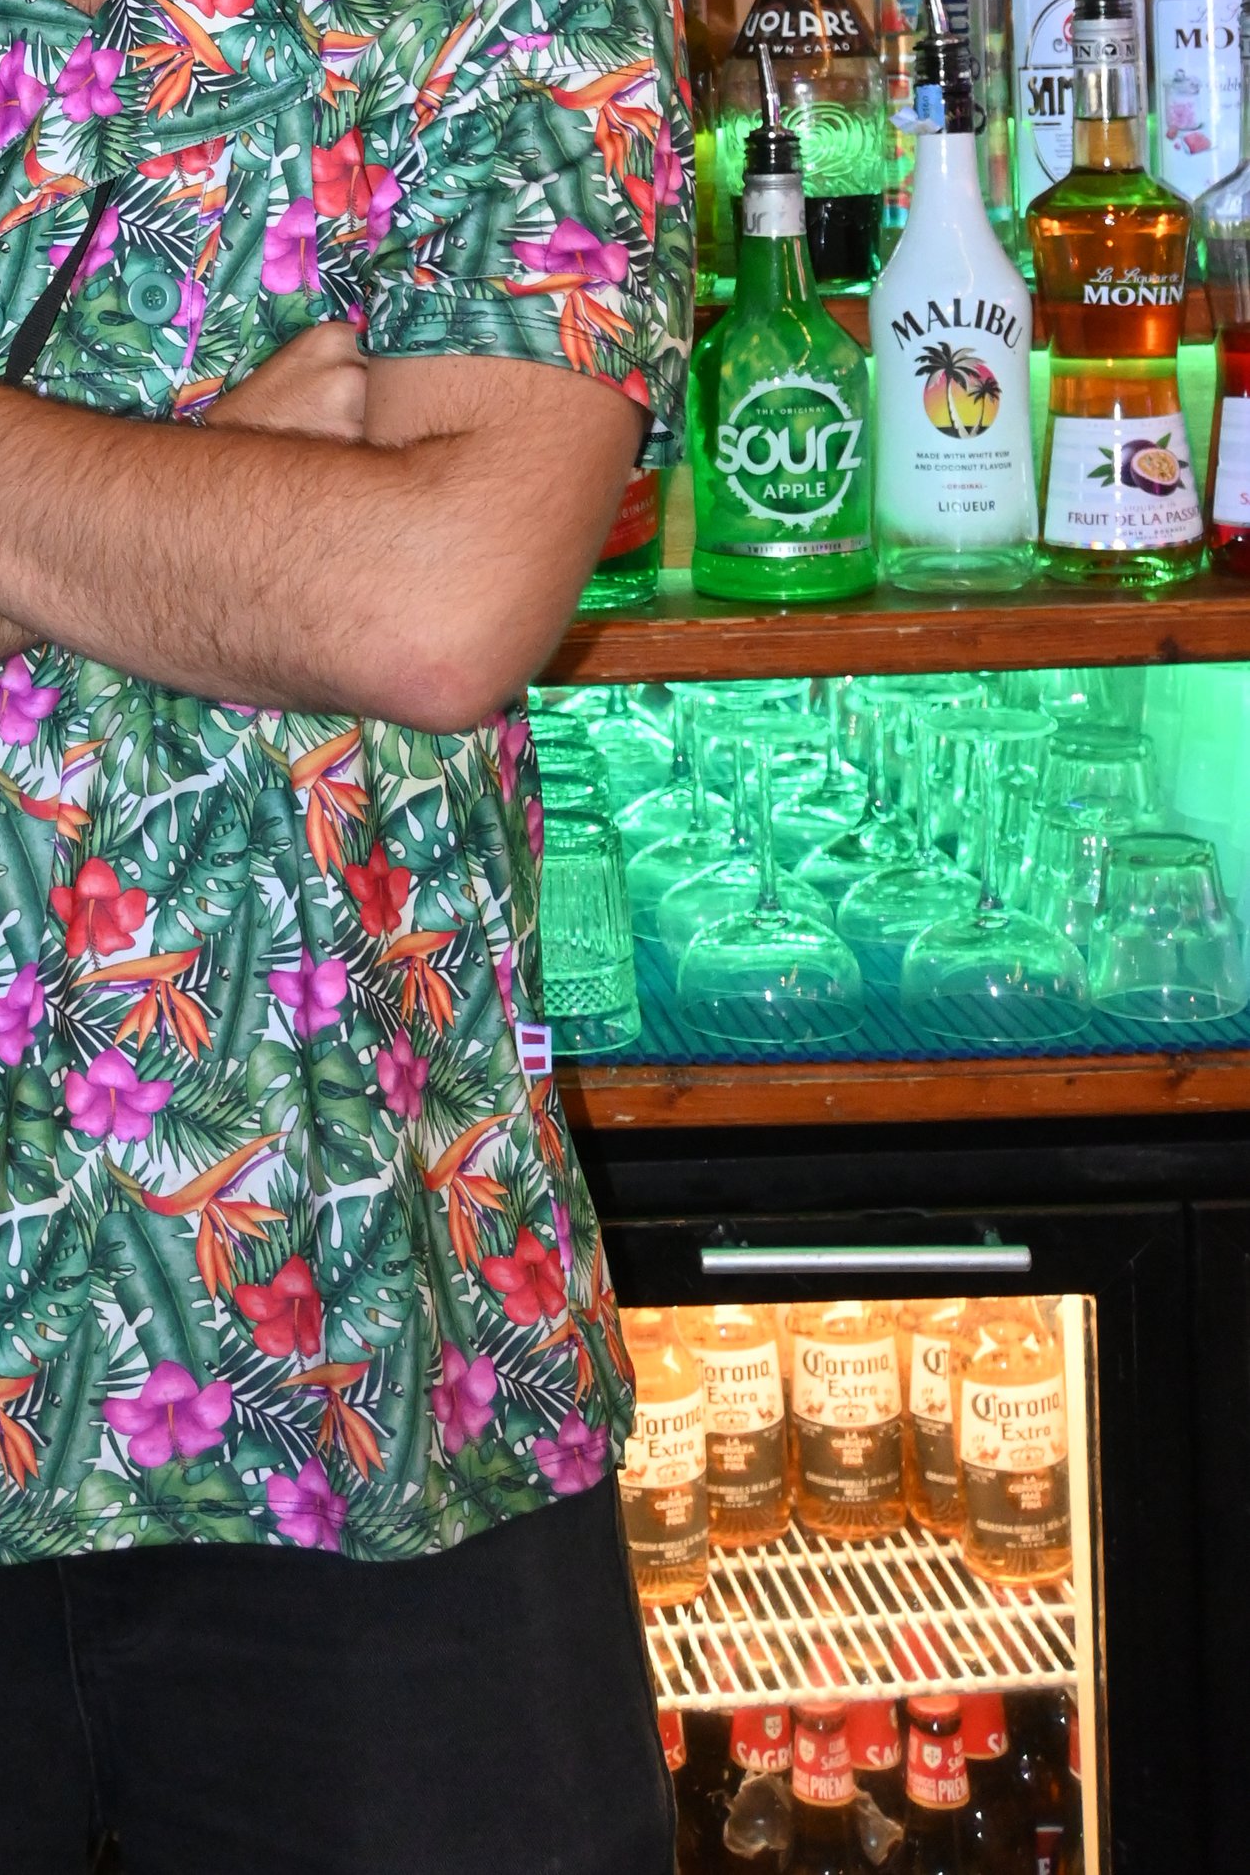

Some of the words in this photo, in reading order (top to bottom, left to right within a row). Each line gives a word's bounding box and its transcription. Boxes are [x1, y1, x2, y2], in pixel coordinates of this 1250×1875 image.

[748, 43, 794, 54] BWN
[803, 42, 851, 54] CACAO
[1089, 266, 1114, 283] La
[1115, 266, 1168, 287] Liqueur
[1083, 284, 1185, 307] MONIN
[891, 298, 1023, 351] MALIBU
[780, 406, 827, 415] ORIGINAL
[916, 452, 941, 460] MADE
[943, 452, 966, 460] WITH
[967, 451, 994, 459] WHITE
[994, 450, 1010, 458] RUM
[915, 463, 934, 471] AND
[934, 463, 978, 472] COCONUT
[979, 462, 1013, 471] FLAVOUR
[762, 482, 827, 500] APPLE
[937, 500, 996, 513] LIQUEUR
[1067, 511, 1109, 526] FRUIT
[1141, 512, 1163, 526] LA
[803, 1348, 890, 1382] Corona
[707, 1385, 758, 1405] Extra
[828, 1379, 877, 1398] Extra
[971, 1392, 1060, 1426] Corona
[1001, 1422, 1051, 1441] Extra
[648, 1439, 695, 1458] Extra
[736, 1740, 793, 1768] SAGR
[865, 1742, 900, 1766] SAG
